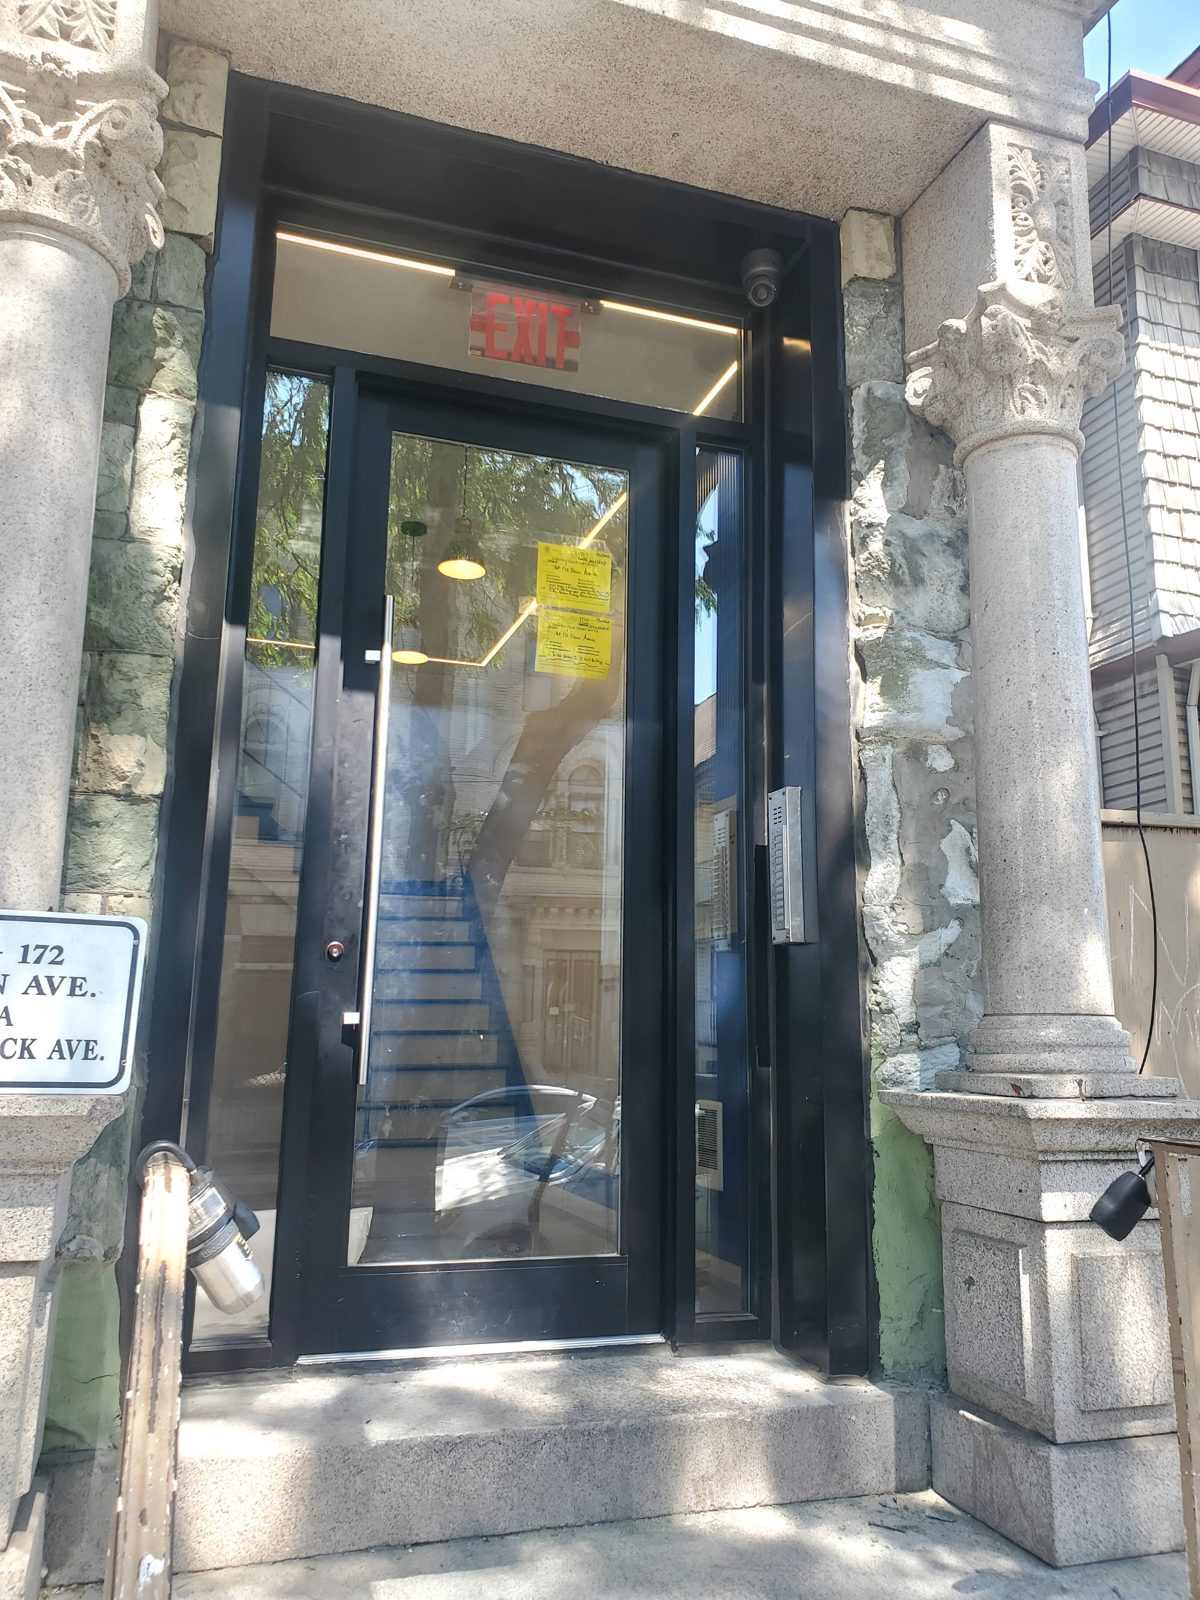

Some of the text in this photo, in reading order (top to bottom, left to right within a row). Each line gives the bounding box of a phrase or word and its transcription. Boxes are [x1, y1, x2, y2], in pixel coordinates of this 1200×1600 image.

[485, 293, 574, 369] EXIT
[18, 944, 65, 966] 172
[21, 974, 97, 998] AVE.
[47, 1038, 105, 1061] AVE.
